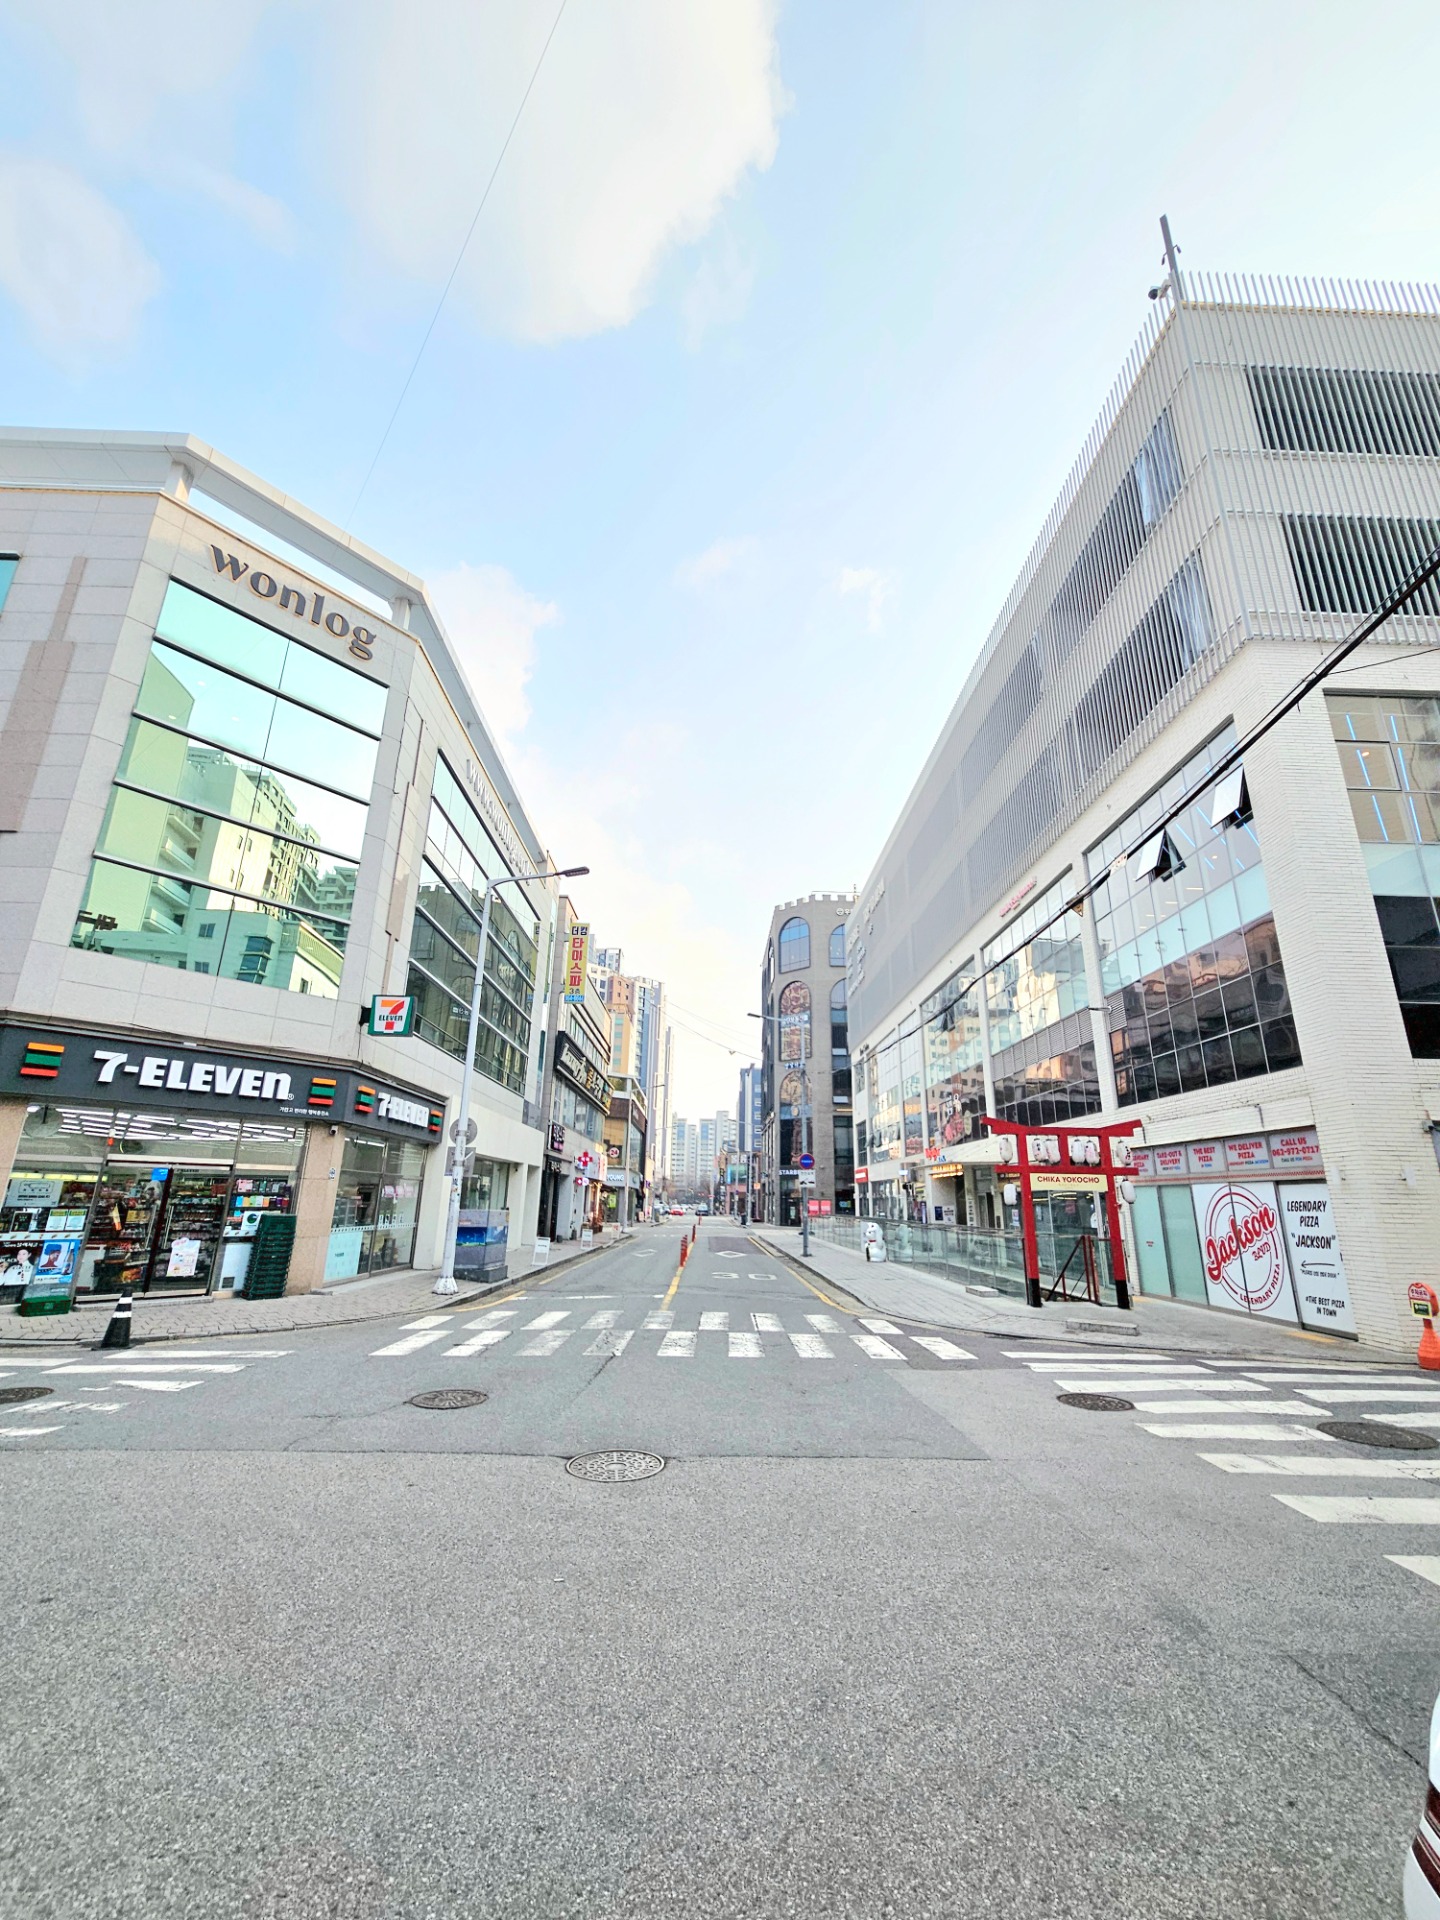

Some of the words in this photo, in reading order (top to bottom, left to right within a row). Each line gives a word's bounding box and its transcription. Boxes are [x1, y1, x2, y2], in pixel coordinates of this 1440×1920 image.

[210, 543, 377, 661] wonlog
[1238, 1141, 1263, 1151] DELIVER
[1280, 1138, 1297, 1147] CALL
[1297, 1137, 1307, 1145] US
[1193, 1147, 1203, 1155] THE
[1203, 1146, 1216, 1154] BEST
[1237, 1151, 1255, 1159] PIZZA
[1271, 1145, 1320, 1157] 062-972-0717
[1198, 1155, 1213, 1163] PIZZA
[606, 1173, 625, 1182] YOUNG
[1037, 1175, 1061, 1183] CHIKA
[1062, 1176, 1100, 1184] YOKOCHO
[1286, 1200, 1327, 1213] LEGENDARY
[1299, 1215, 1320, 1228] PIZZA
[1206, 1206, 1276, 1281] Jackson
[1271, 1263, 1281, 1290] PIZZA
[1318, 1296, 1330, 1306] BEST
[1331, 1299, 1345, 1309] PIZZA
[1316, 1306, 1322, 1315] IN
[1322, 1307, 1337, 1317] TOWN
